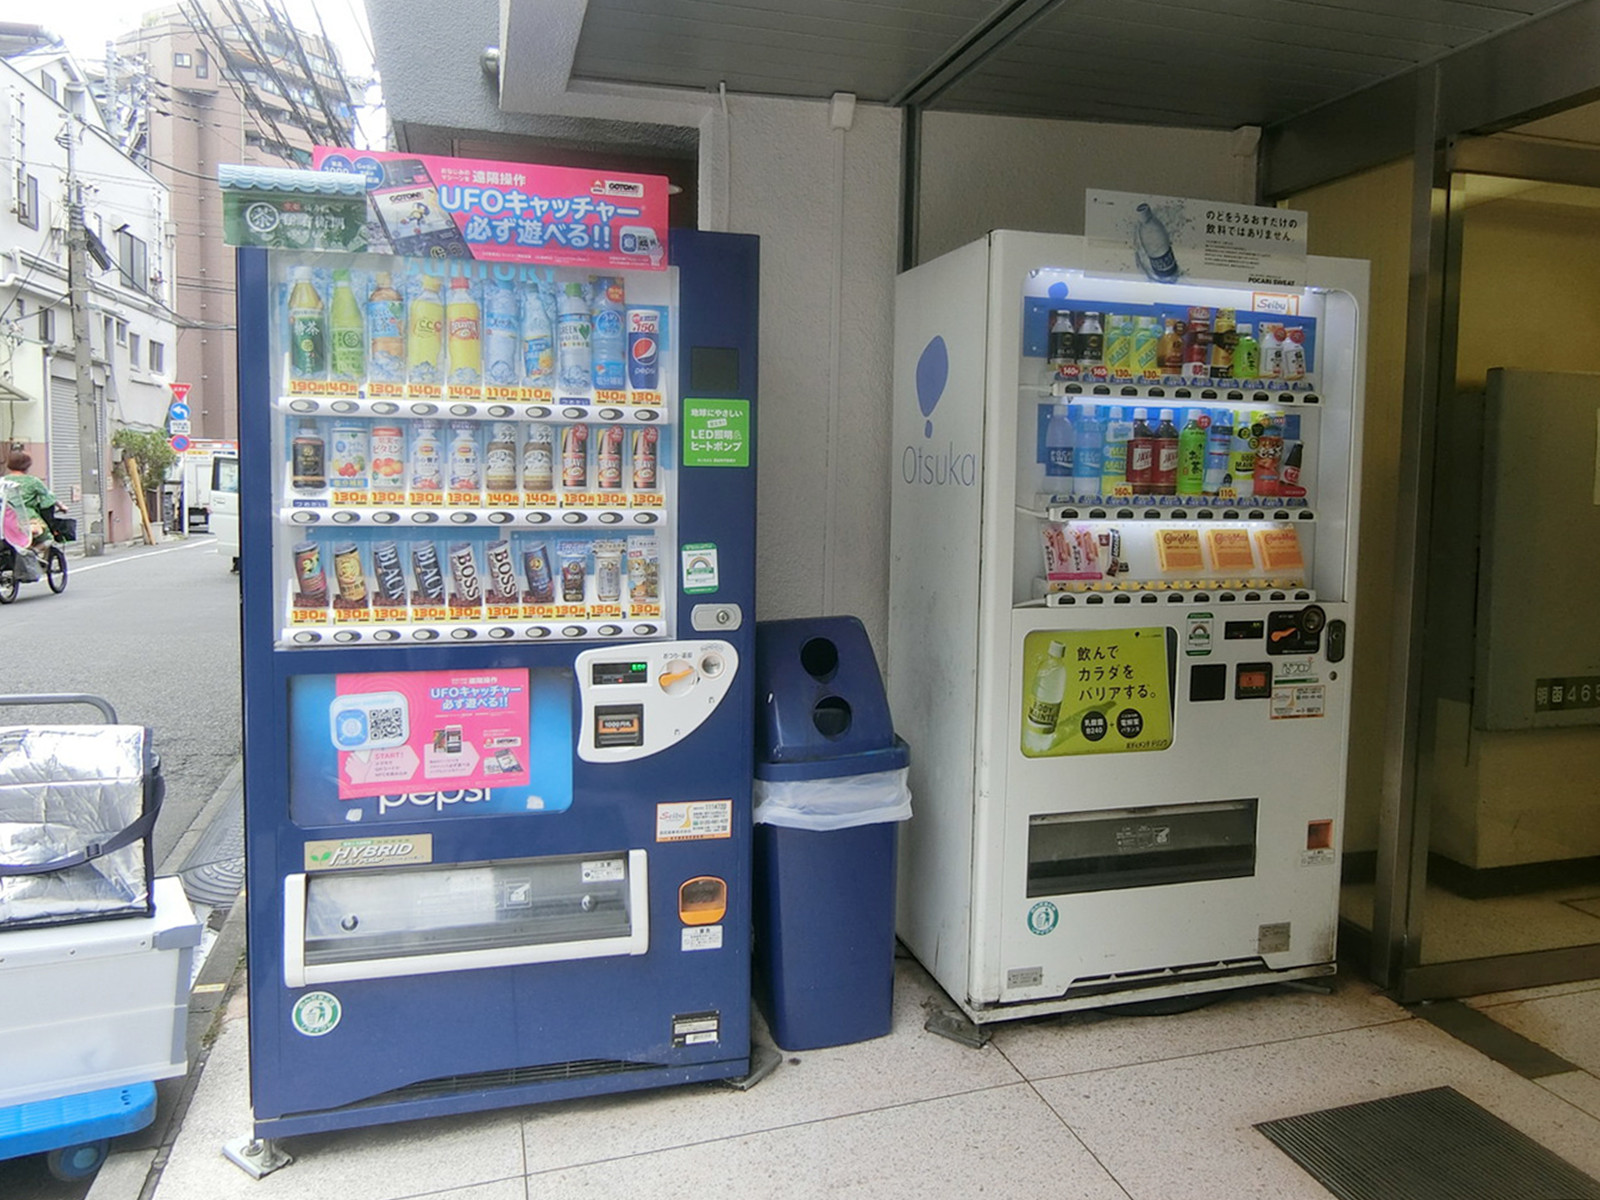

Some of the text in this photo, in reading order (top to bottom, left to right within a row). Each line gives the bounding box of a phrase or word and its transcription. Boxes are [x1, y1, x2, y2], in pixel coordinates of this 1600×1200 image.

[472, 170, 526, 187] 遠隔操作
[440, 185, 640, 223] UFOキャッチャー
[1205, 209, 1298, 230] のどをうるおすだけの
[467, 215, 610, 249] 必ず遊べる!!
[1205, 222, 1296, 243] 飲料ではありません。
[1257, 299, 1286, 311] Seibu
[690, 441, 743, 453] ヒートポンプ
[902, 441, 976, 487] Otsuka
[377, 546, 406, 601] BLACK
[416, 544, 445, 599] BLACK
[454, 551, 480, 602] BOSS
[492, 547, 518, 598] BOSS
[1076, 644, 1119, 662] 飲んで
[1078, 664, 1135, 682] カラダを
[1078, 684, 1158, 701] バリアする。
[328, 842, 414, 867] HYBRID
